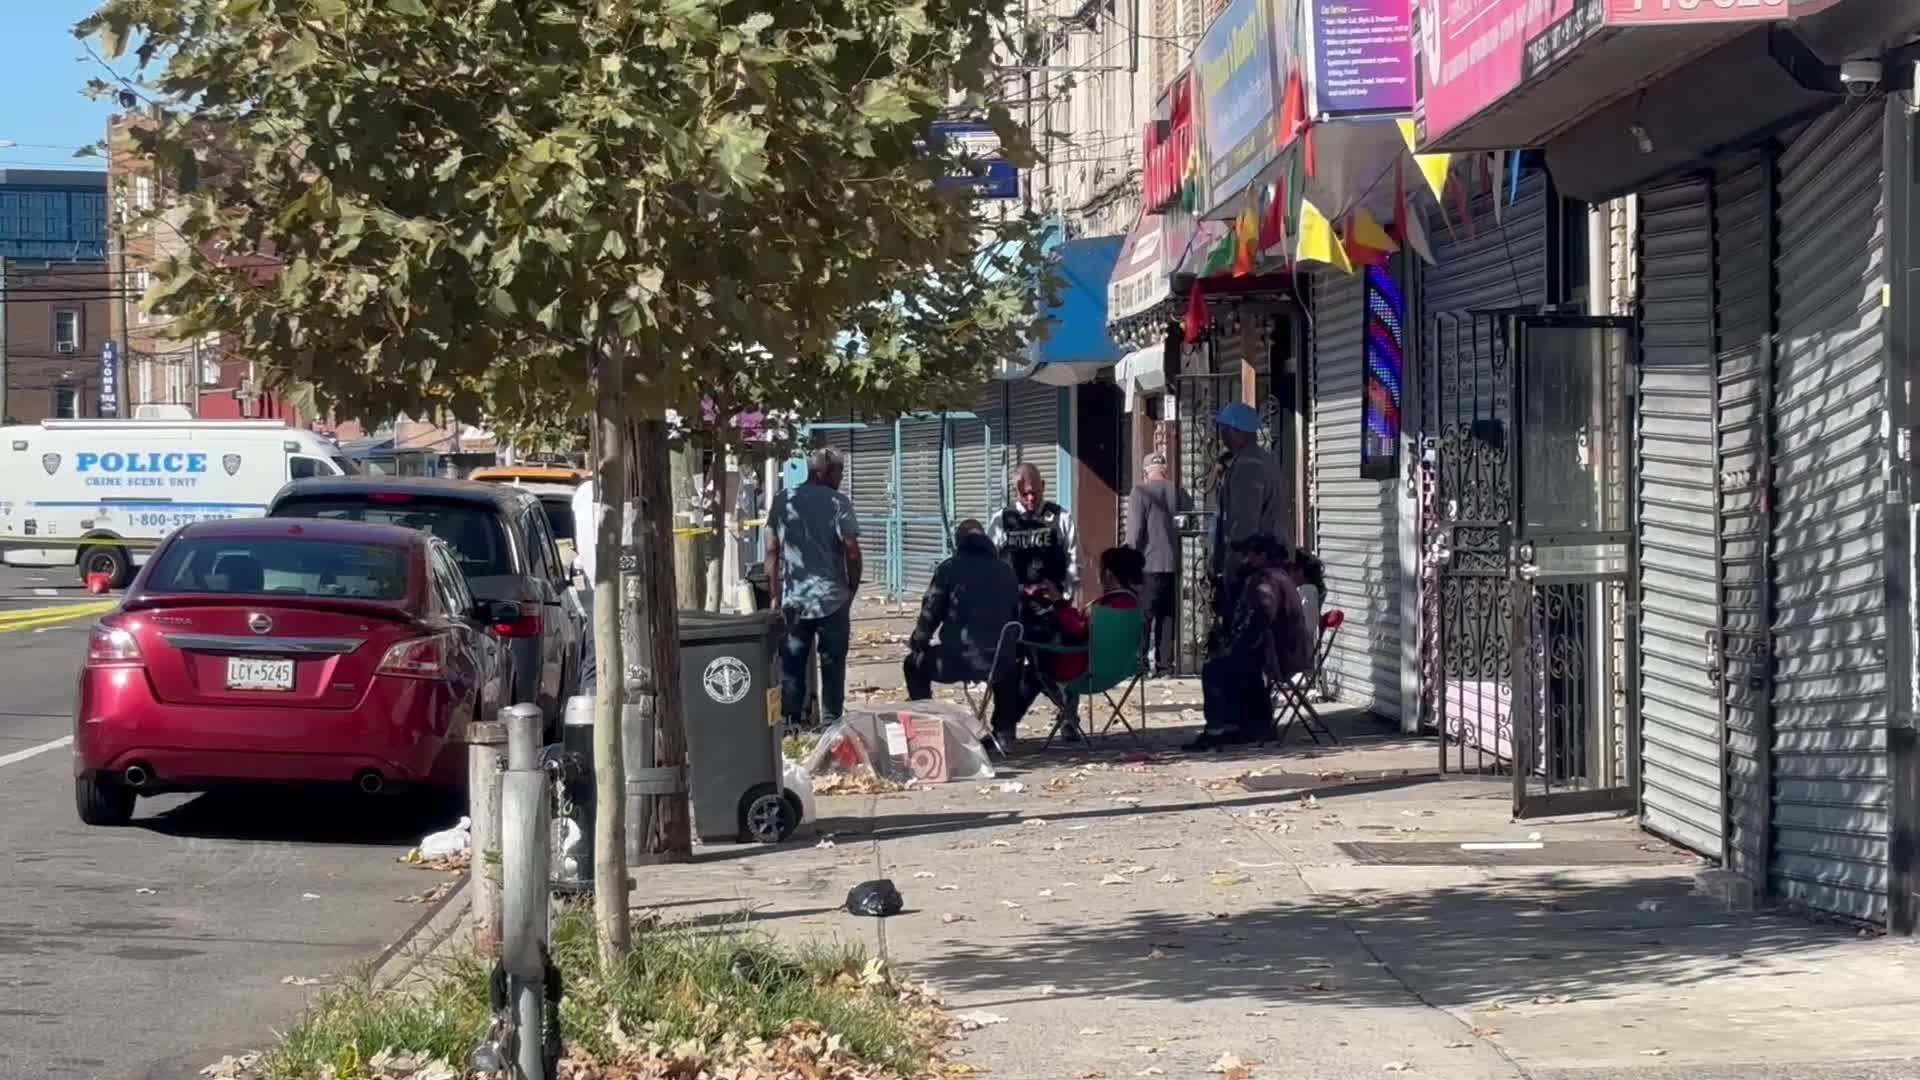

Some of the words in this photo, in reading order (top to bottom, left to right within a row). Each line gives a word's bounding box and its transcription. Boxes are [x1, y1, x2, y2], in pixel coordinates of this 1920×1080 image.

[76, 452, 208, 473] POLICE
[85, 477, 123, 487] CRIME
[127, 477, 164, 487] SCENE
[169, 477, 197, 487] UNIT
[1008, 531, 1051, 549] POLICE
[260, 664, 290, 682] 5245
